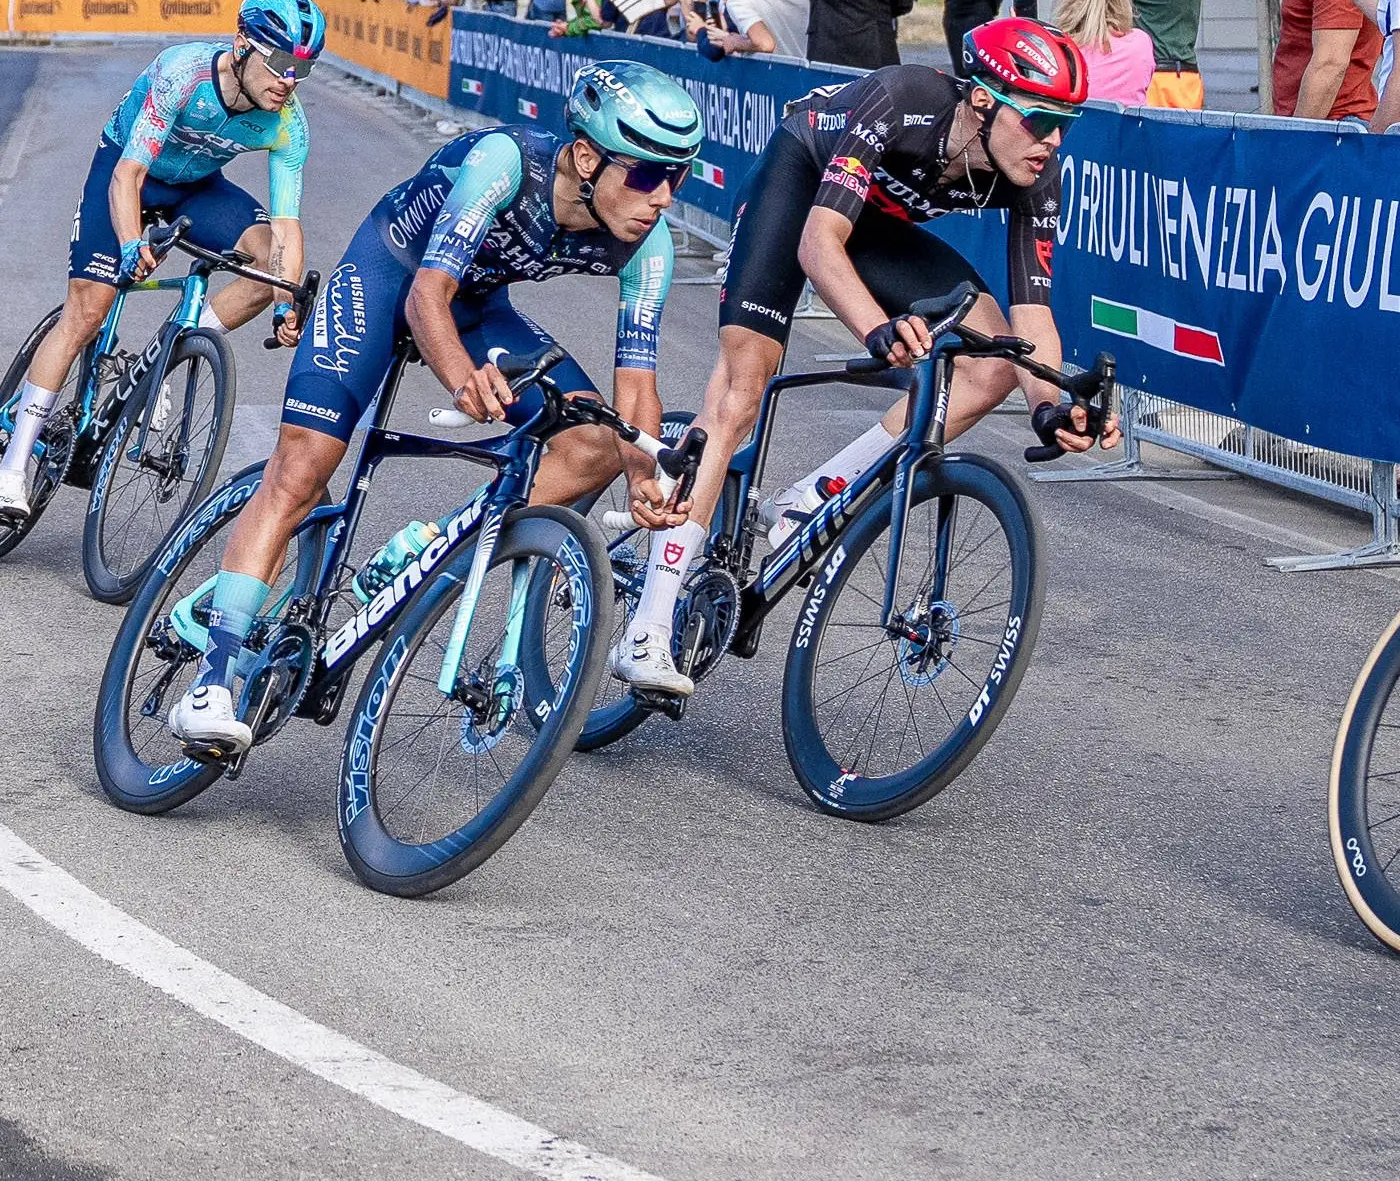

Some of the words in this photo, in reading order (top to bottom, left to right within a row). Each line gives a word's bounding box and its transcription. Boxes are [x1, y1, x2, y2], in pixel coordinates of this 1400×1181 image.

[850, 122, 885, 153] MSC
[903, 114, 934, 127] BMC
[1032, 216, 1057, 229] MS
[1076, 159, 1149, 268] FRIULI
[1150, 176, 1287, 296] VENEZIA
[349, 276, 366, 334] BUSINESS
[741, 300, 788, 325] sportful
[285, 397, 342, 420] Bianchi
[323, 489, 489, 669] Bianchi
[655, 565, 681, 577] TUDOR
[796, 586, 828, 649] SWISS
[990, 615, 1022, 686] SWISS
[968, 683, 992, 727] DT
